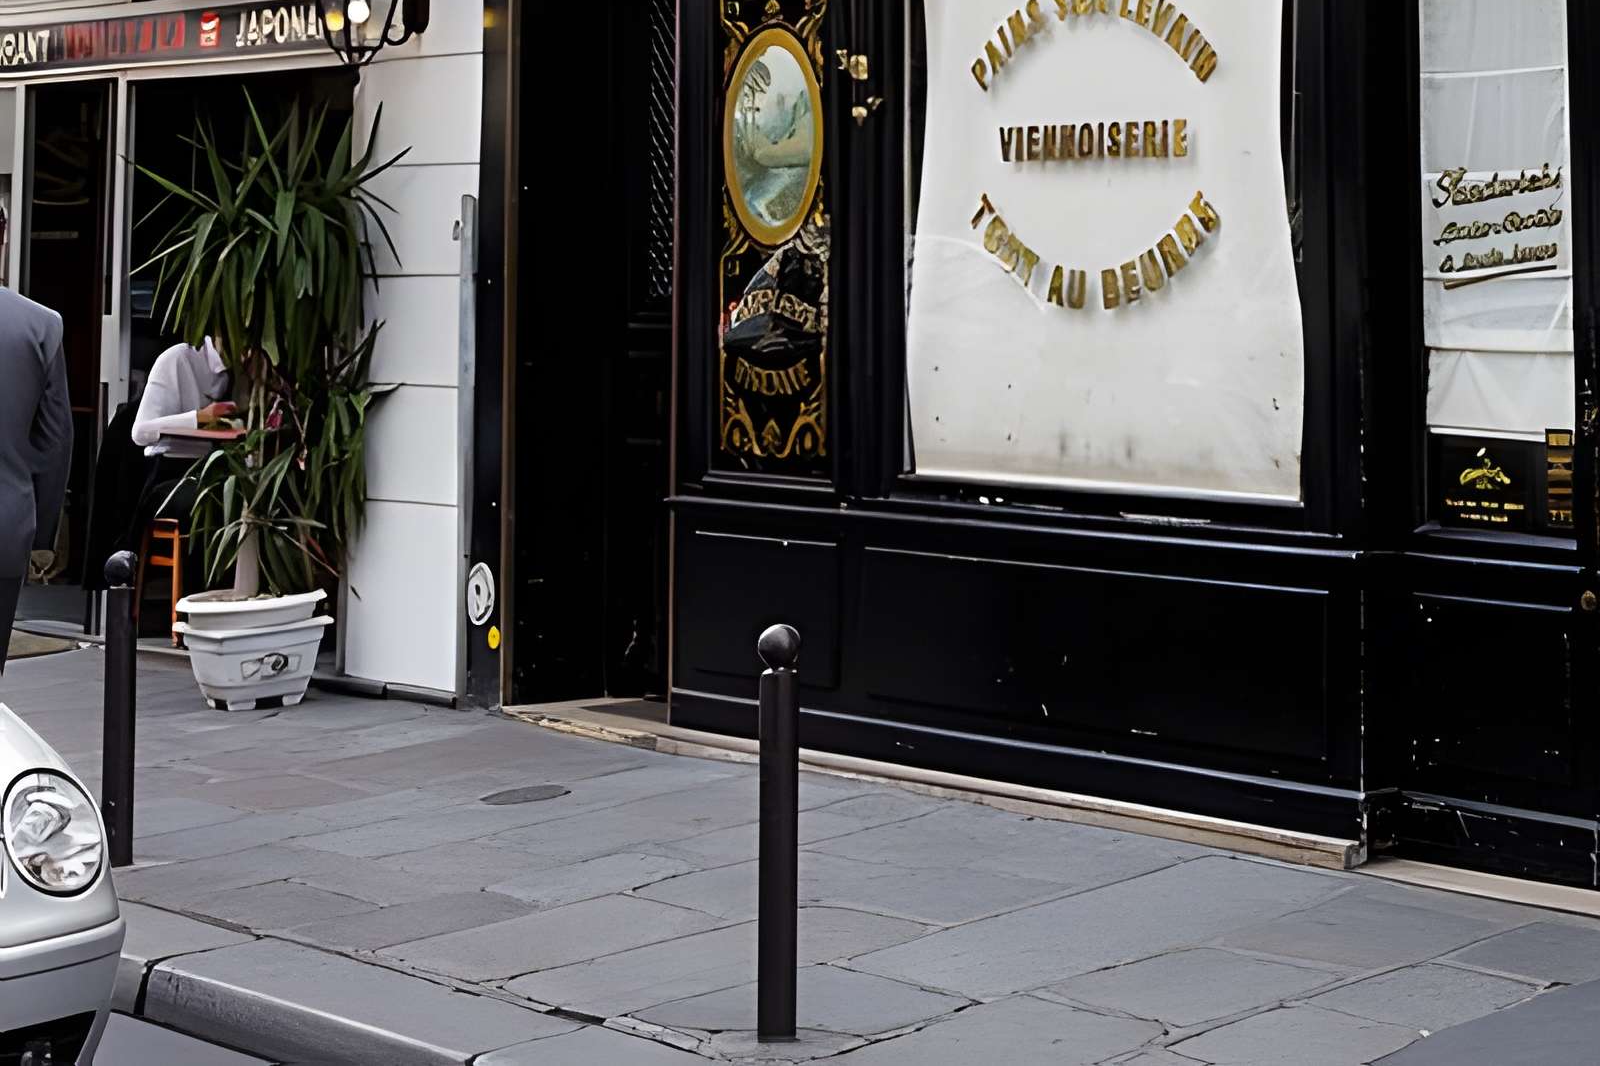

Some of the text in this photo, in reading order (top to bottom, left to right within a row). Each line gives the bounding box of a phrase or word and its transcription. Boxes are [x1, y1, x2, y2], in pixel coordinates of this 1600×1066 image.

[235, 4, 325, 48] JAPONA
[999, 118, 1188, 163] VIENNOISERIE
[1047, 265, 1087, 310] AU
[1100, 190, 1220, 311] BEURRE
